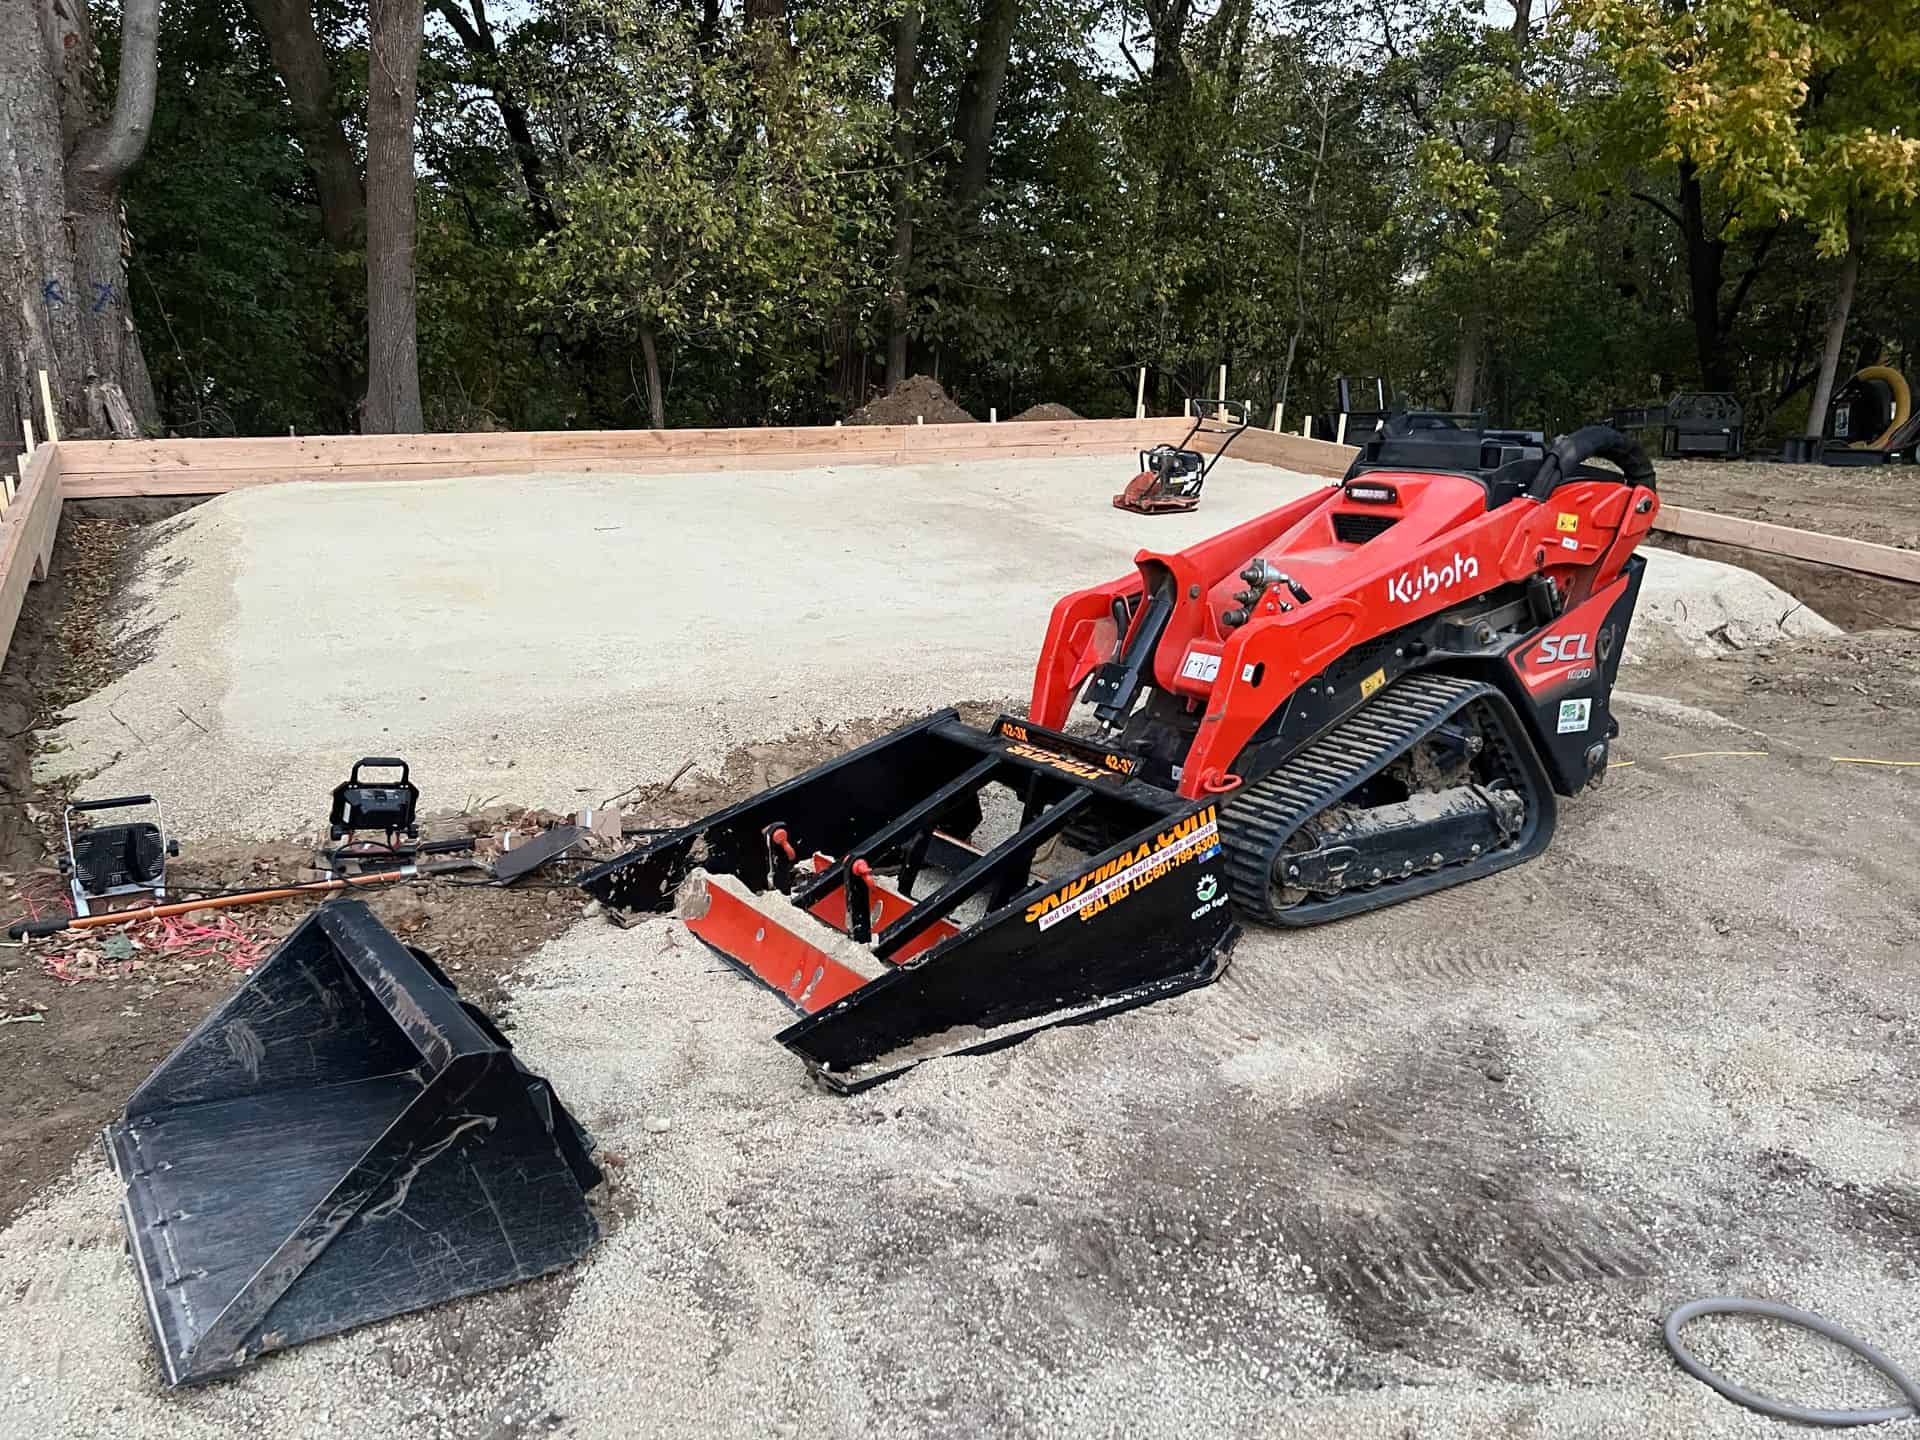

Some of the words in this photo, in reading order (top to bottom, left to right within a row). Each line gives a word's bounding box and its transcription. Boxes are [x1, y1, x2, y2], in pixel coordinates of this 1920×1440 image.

[1388, 552, 1479, 603] Kubota
[1536, 633, 1592, 664] SCL
[1061, 902, 1077, 915] the
[1079, 886, 1103, 906] rough
[1105, 874, 1126, 891] ways
[1127, 859, 1149, 878] shall
[1079, 897, 1109, 921] SEAL
